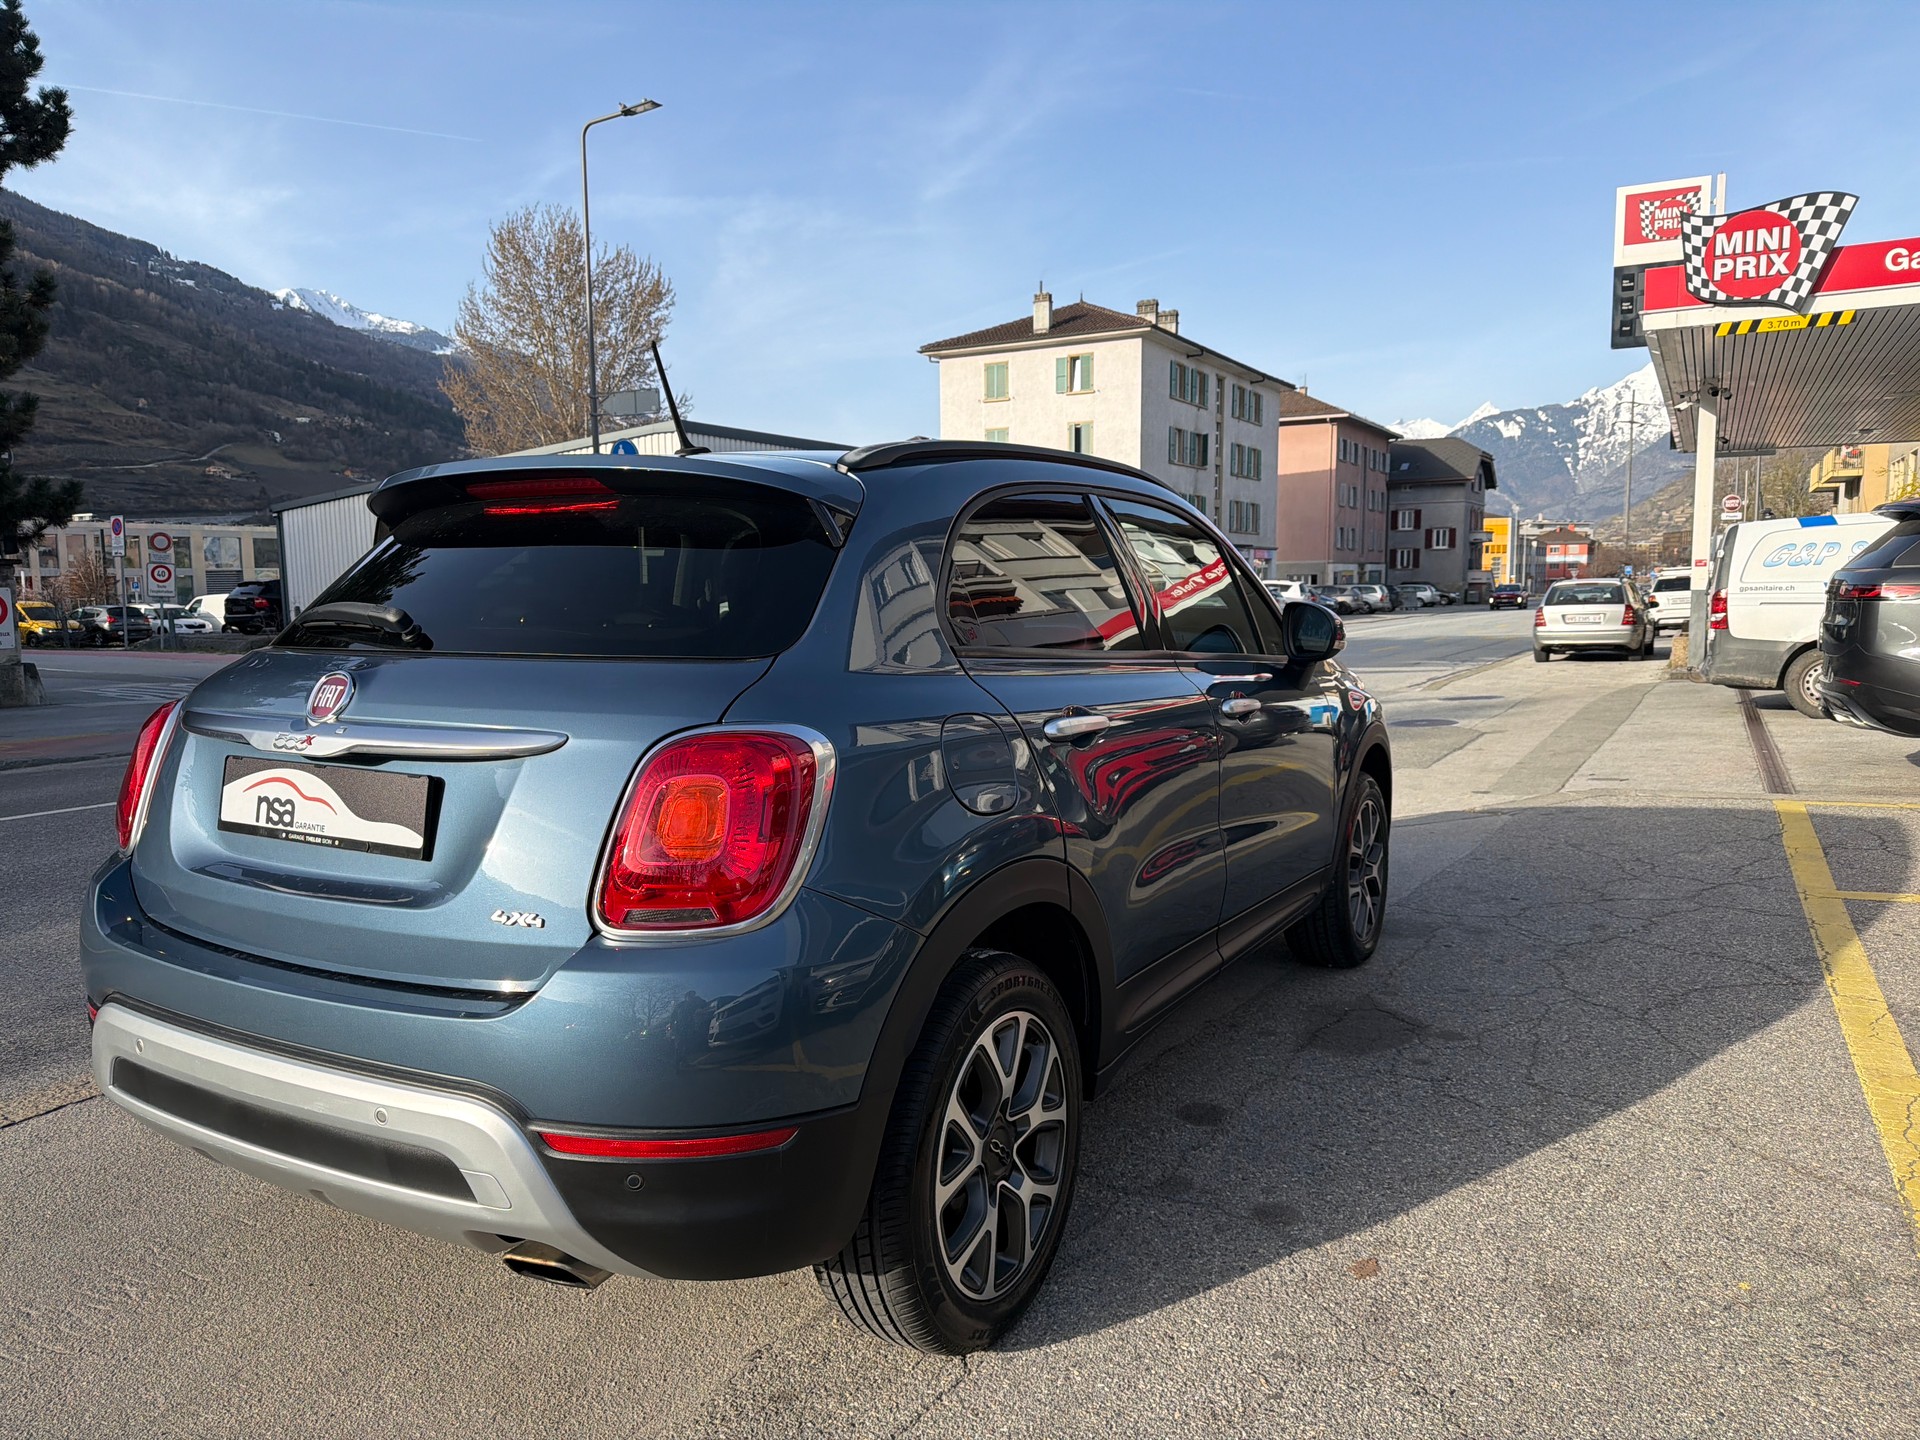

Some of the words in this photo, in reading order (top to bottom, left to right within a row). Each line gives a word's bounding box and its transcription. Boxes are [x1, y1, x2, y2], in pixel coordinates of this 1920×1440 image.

[1714, 225, 1792, 257] MINI
[1712, 251, 1791, 282] PRIX
[1763, 541, 1842, 567] G&P
[156, 570, 166, 578] 40
[1739, 584, 1796, 593] gpsanitaire.ch
[313, 684, 344, 708] FIAT
[255, 795, 296, 829] nsa
[294, 821, 326, 834] GARANTIE
